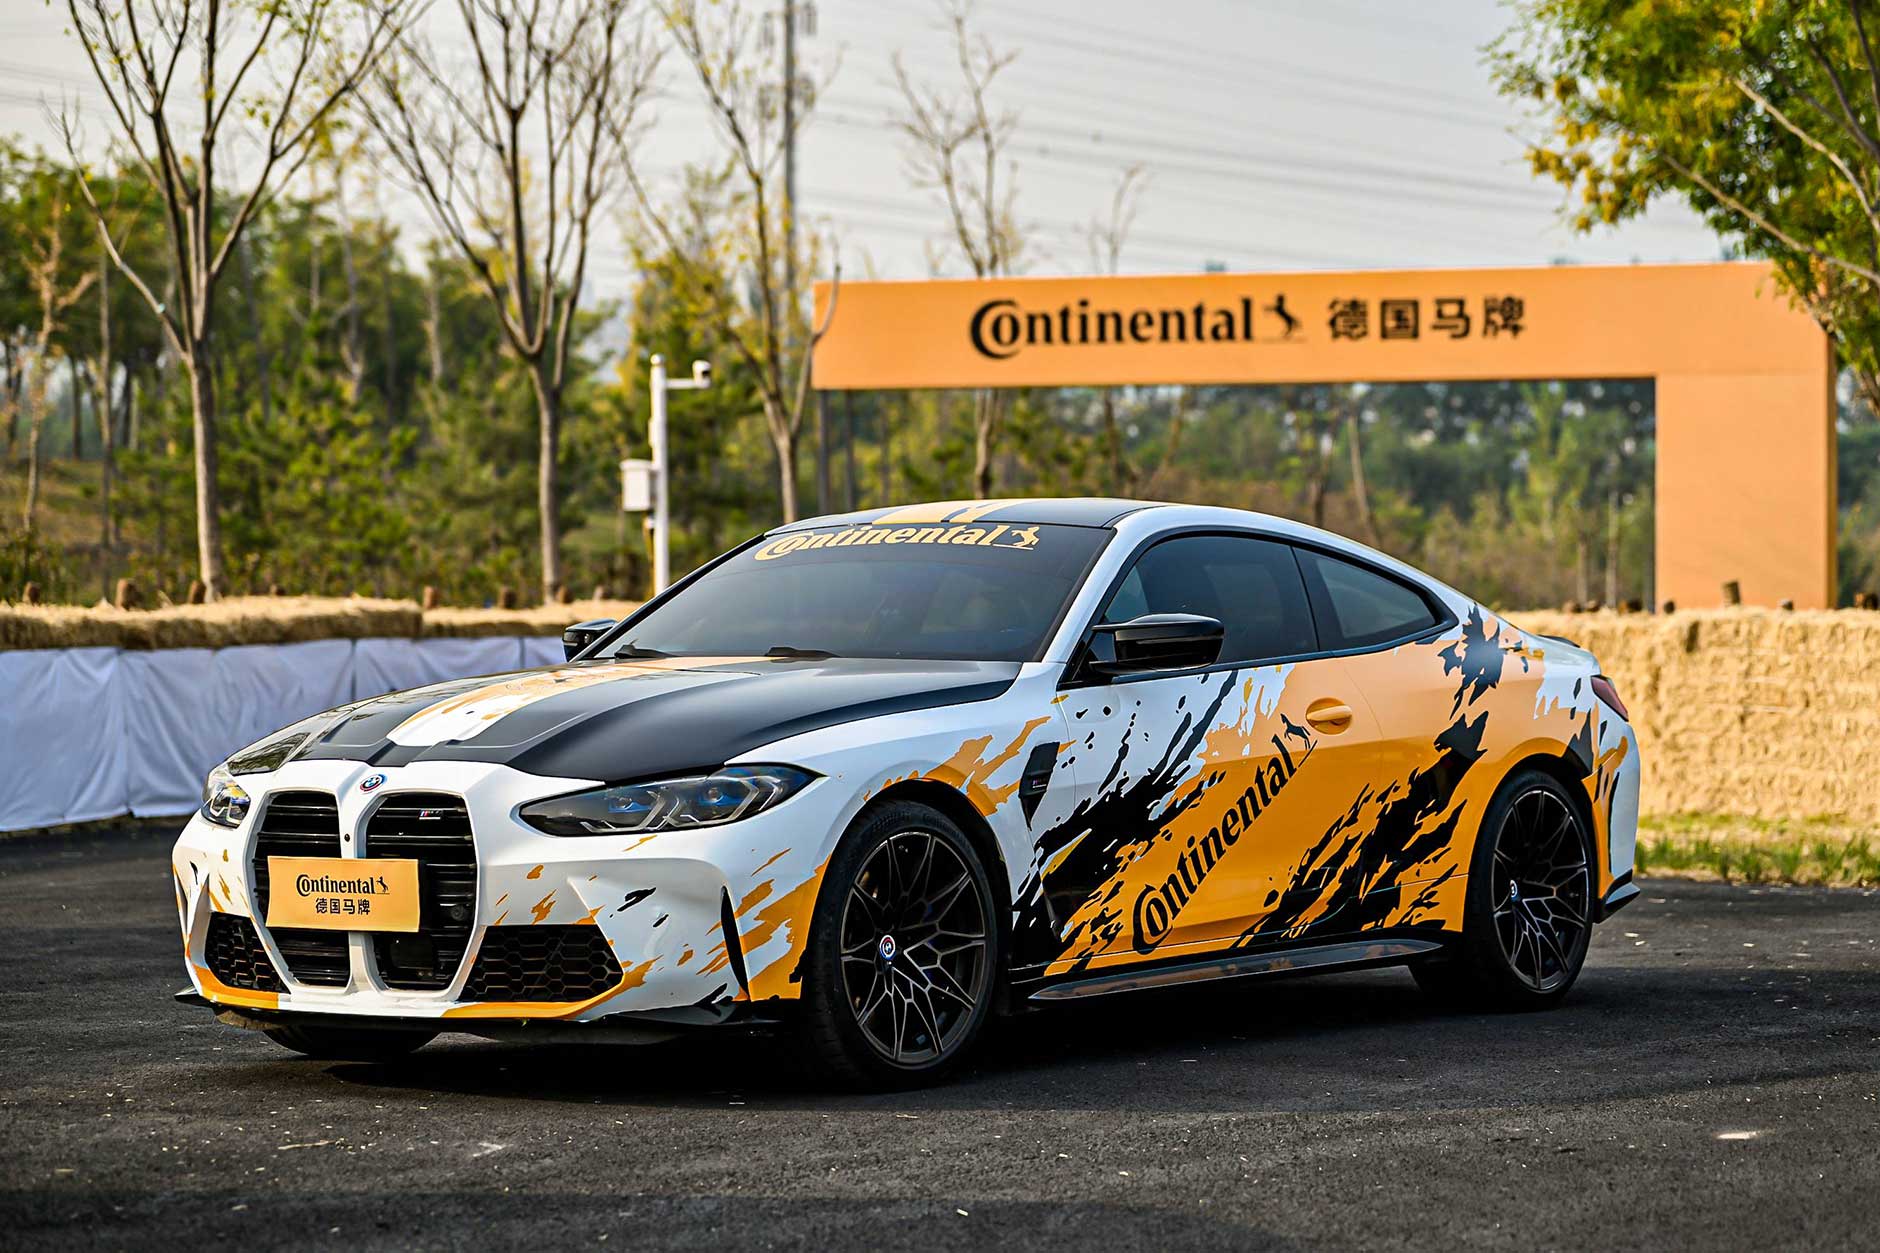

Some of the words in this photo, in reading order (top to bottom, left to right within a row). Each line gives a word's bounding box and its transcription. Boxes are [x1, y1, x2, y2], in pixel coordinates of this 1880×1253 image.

[970, 298, 1254, 359] Continental
[1327, 296, 1526, 340] 德国马牌
[754, 525, 1010, 561] Continental
[1132, 735, 1297, 954] Continental
[296, 874, 375, 896] Continental
[315, 897, 370, 914] 德国马牌
